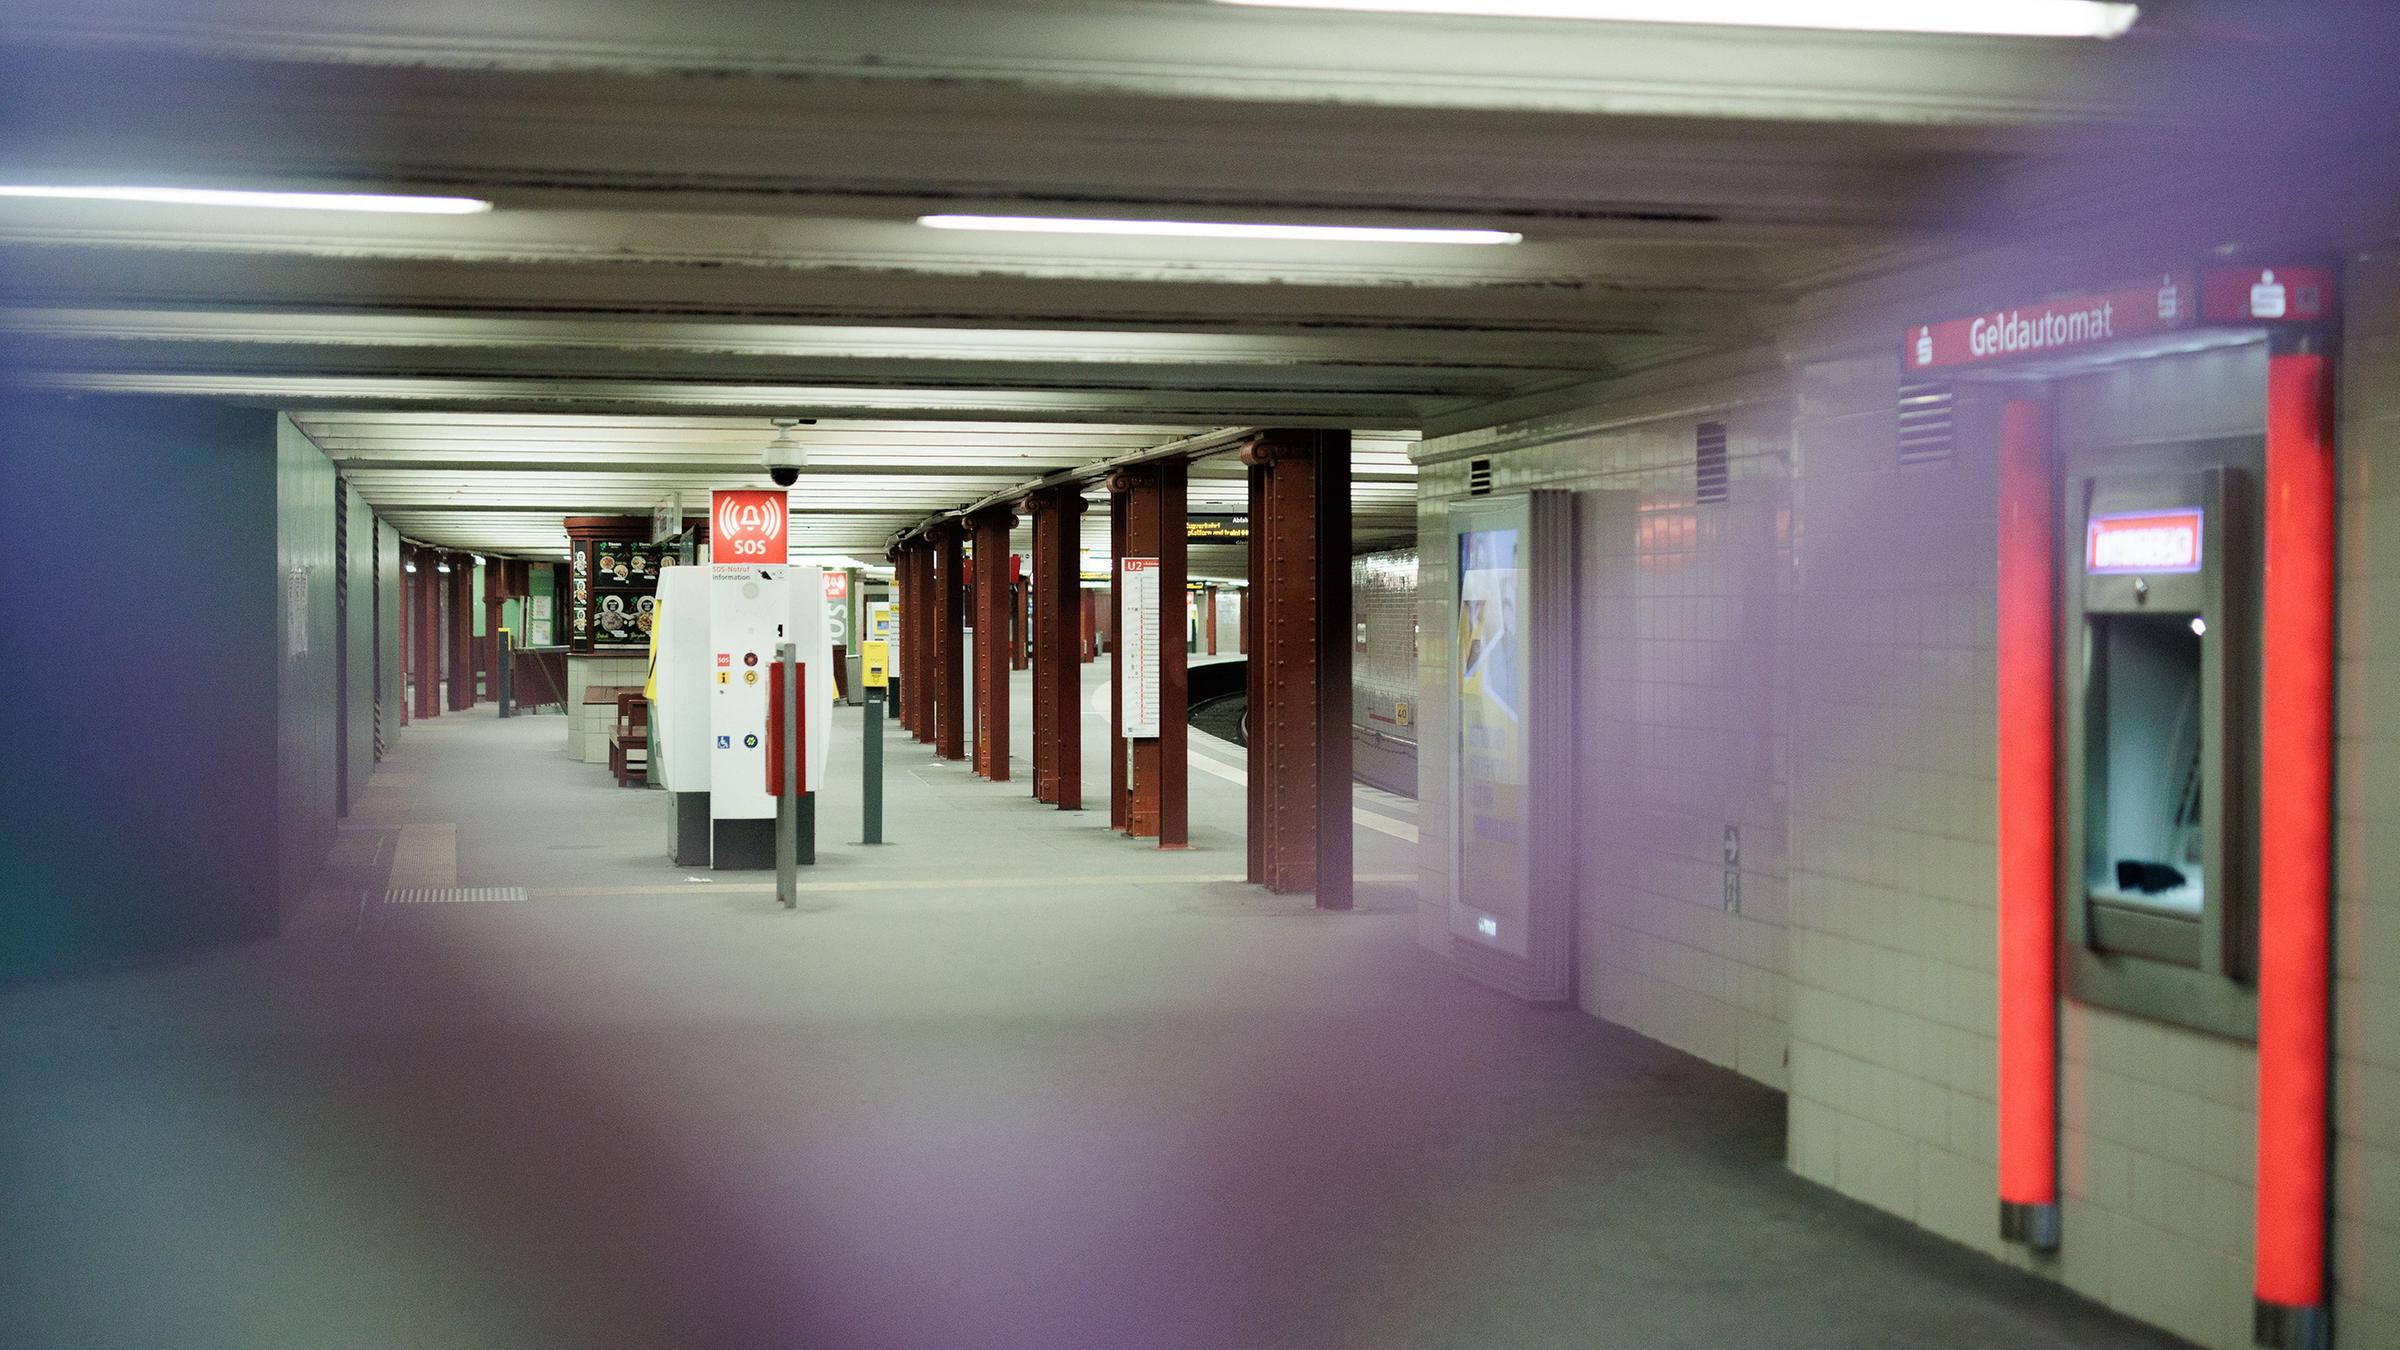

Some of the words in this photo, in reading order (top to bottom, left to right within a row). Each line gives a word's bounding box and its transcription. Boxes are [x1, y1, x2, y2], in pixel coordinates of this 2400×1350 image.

[1970, 300, 2113, 357] Geldautomat
[734, 540, 766, 554] SOS
[1128, 561, 1142, 570] U2
[712, 573, 751, 581] Information
[1397, 709, 1407, 719] 40
